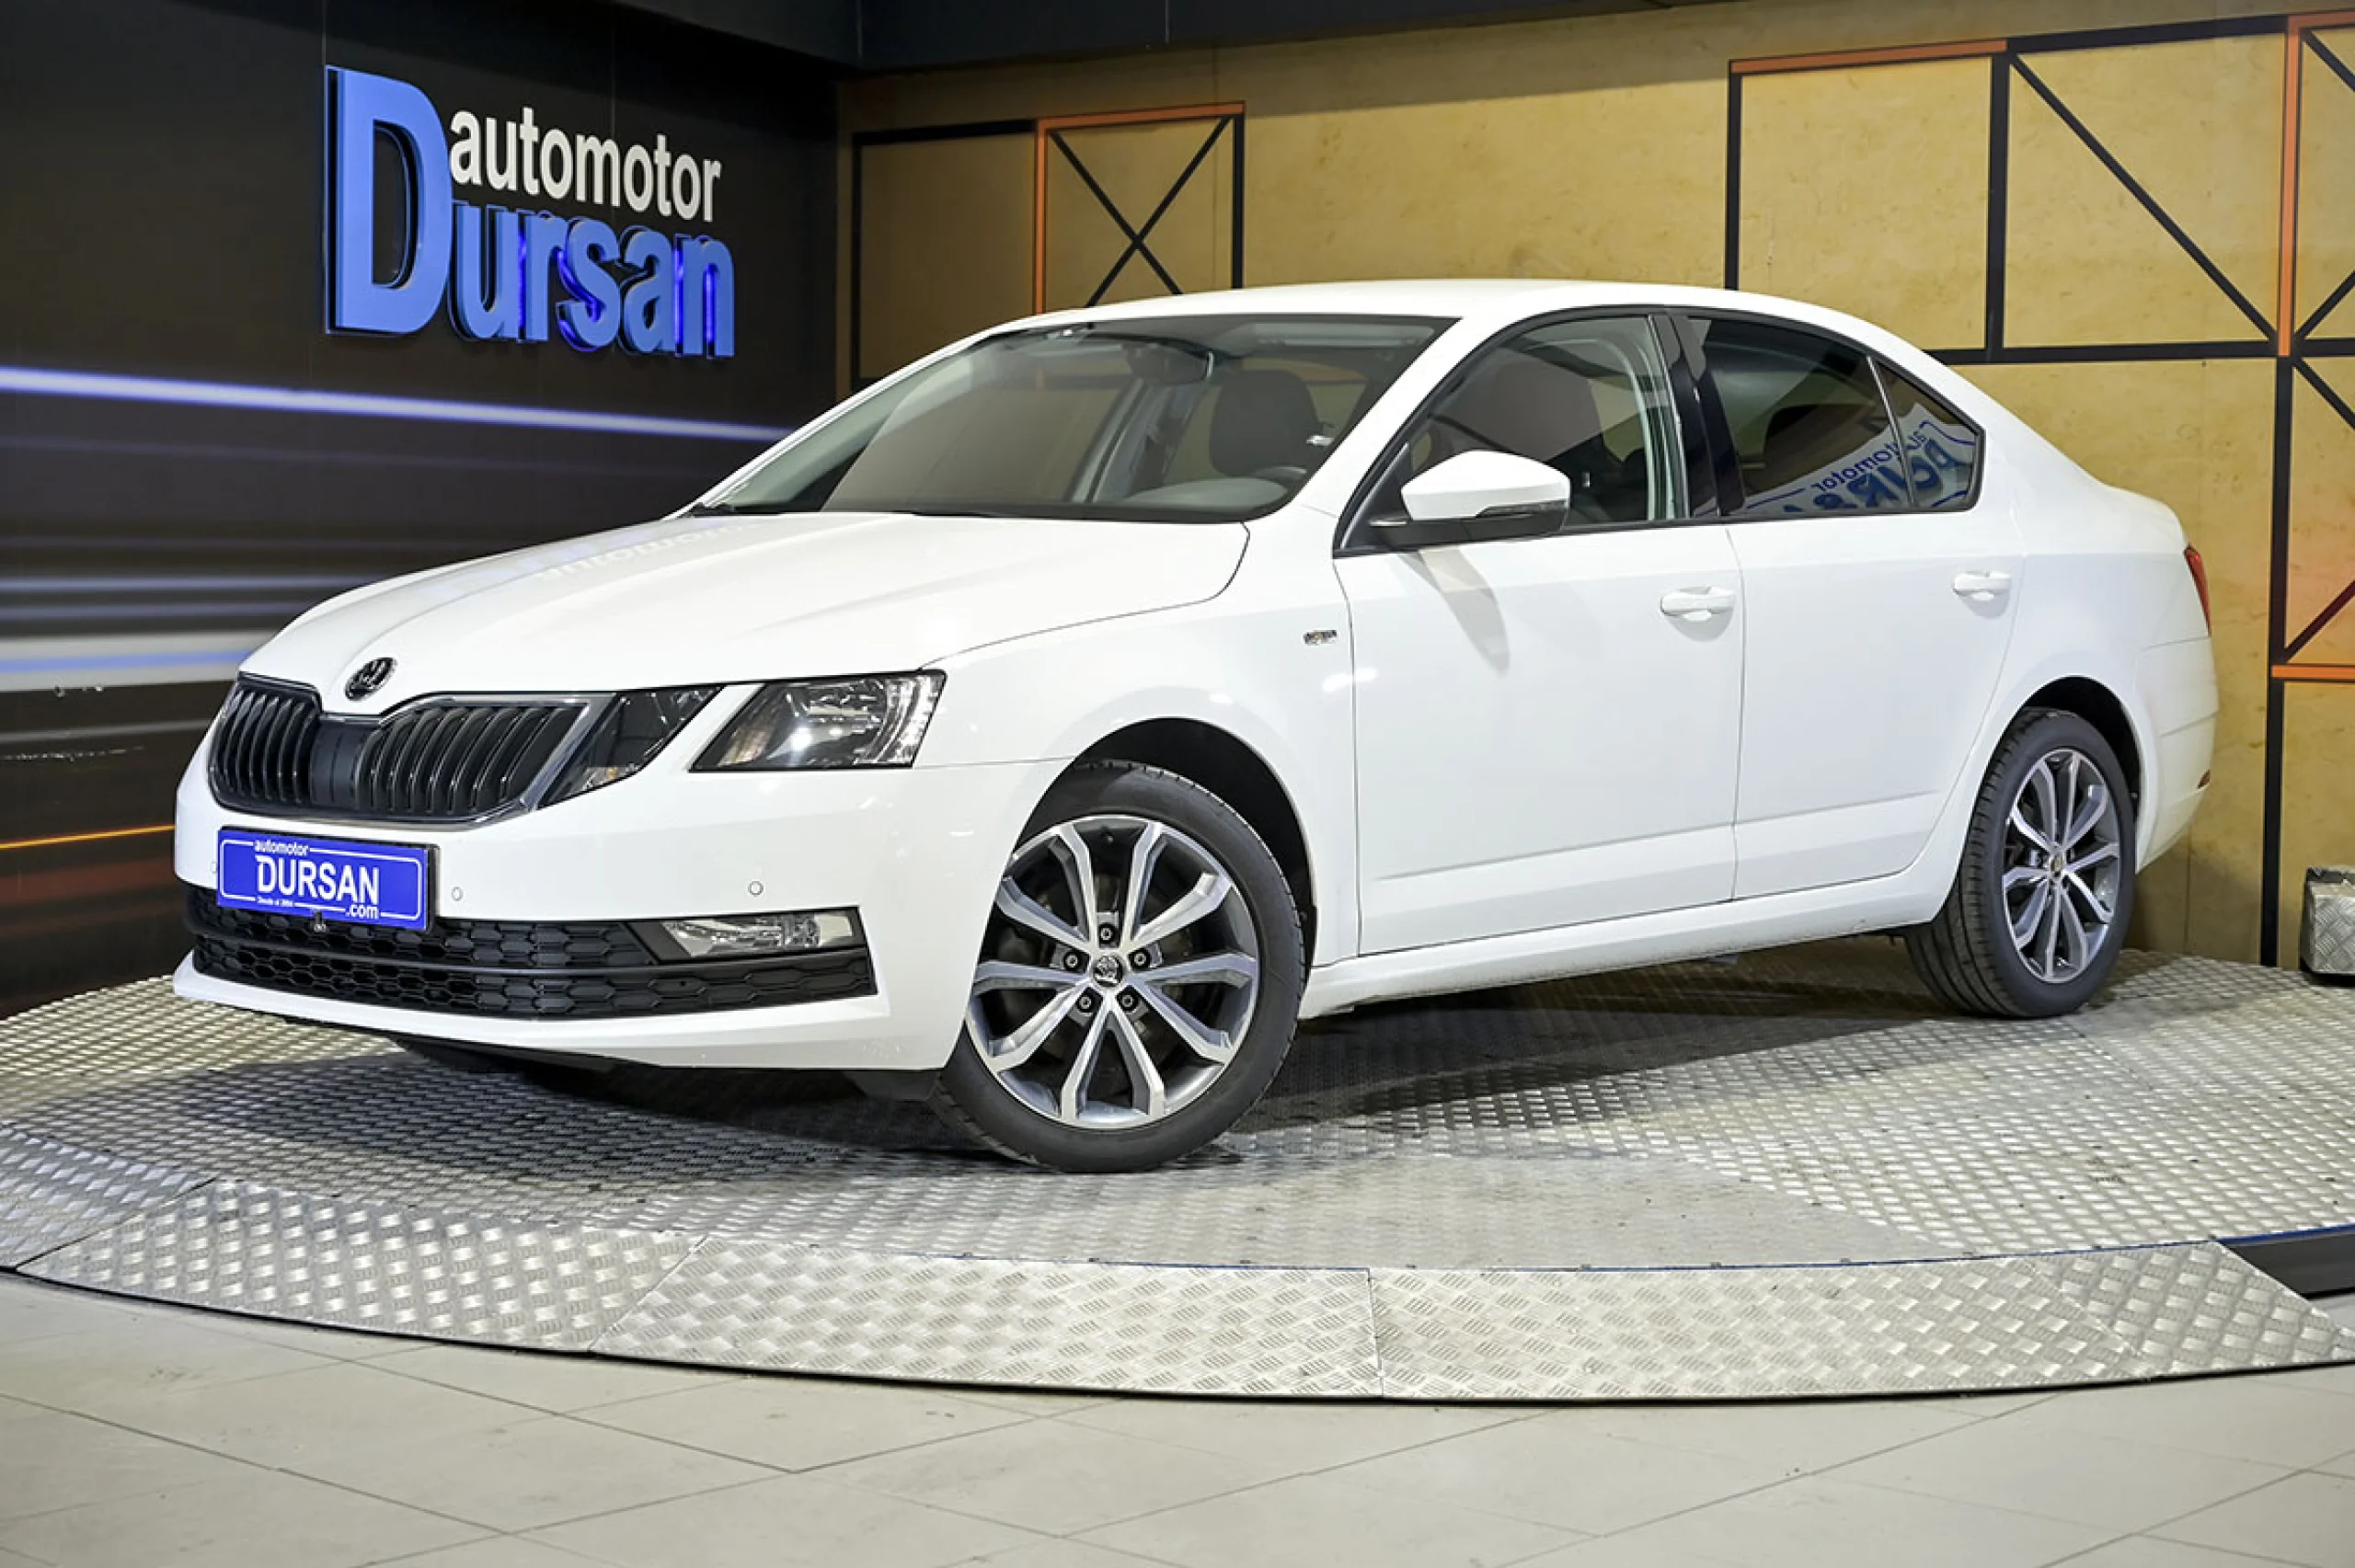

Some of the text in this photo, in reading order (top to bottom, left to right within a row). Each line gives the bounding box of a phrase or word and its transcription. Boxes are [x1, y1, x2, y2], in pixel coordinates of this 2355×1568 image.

[450, 107, 721, 222] automotor
[325, 64, 735, 357] Dursan
[255, 839, 309, 855] automotor
[255, 856, 379, 904] DURSAN
[346, 904, 379, 920] .com
